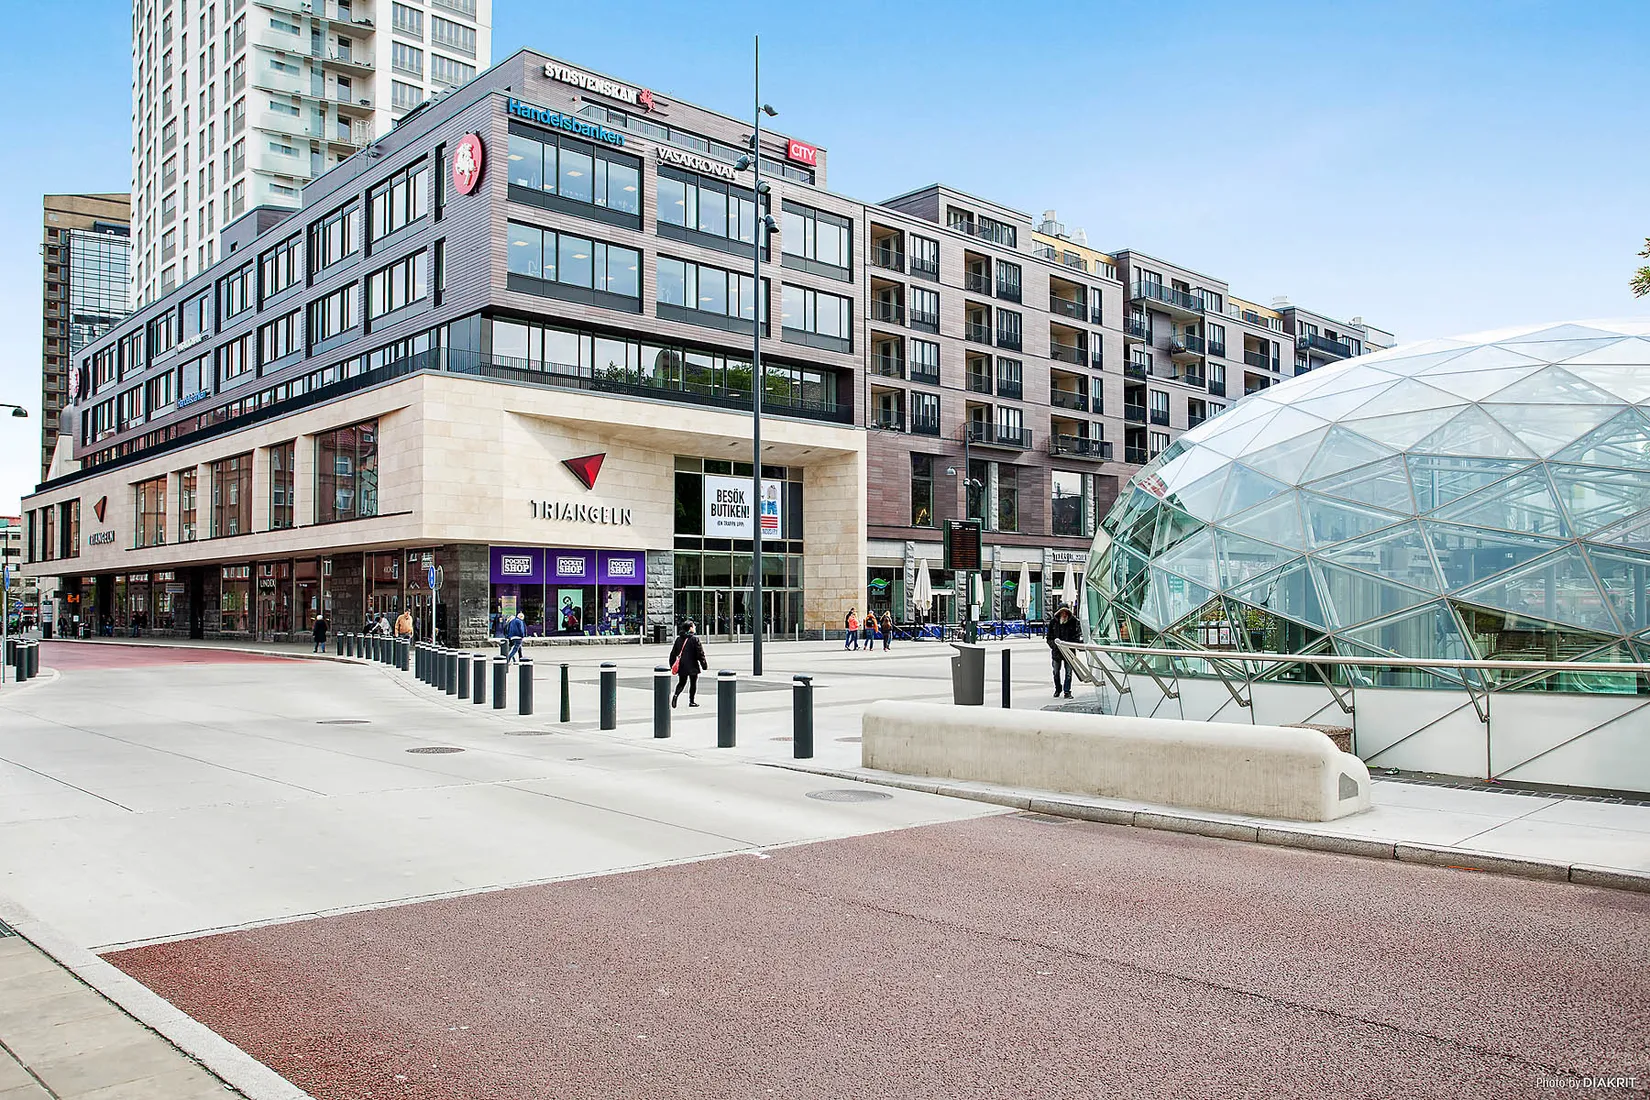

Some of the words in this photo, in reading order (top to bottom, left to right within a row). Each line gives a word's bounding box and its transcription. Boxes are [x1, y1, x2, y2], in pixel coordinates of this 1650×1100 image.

[544, 62, 638, 105] SYDSVENSKAN
[508, 97, 625, 146] Handelsbanken
[791, 143, 815, 161] CITY
[657, 147, 739, 180] VASAKRONAN
[717, 488, 745, 504] BESÖK
[530, 500, 632, 525] TRIANGELN
[711, 503, 750, 519] BUTIKEN!
[504, 564, 530, 572] SHOP
